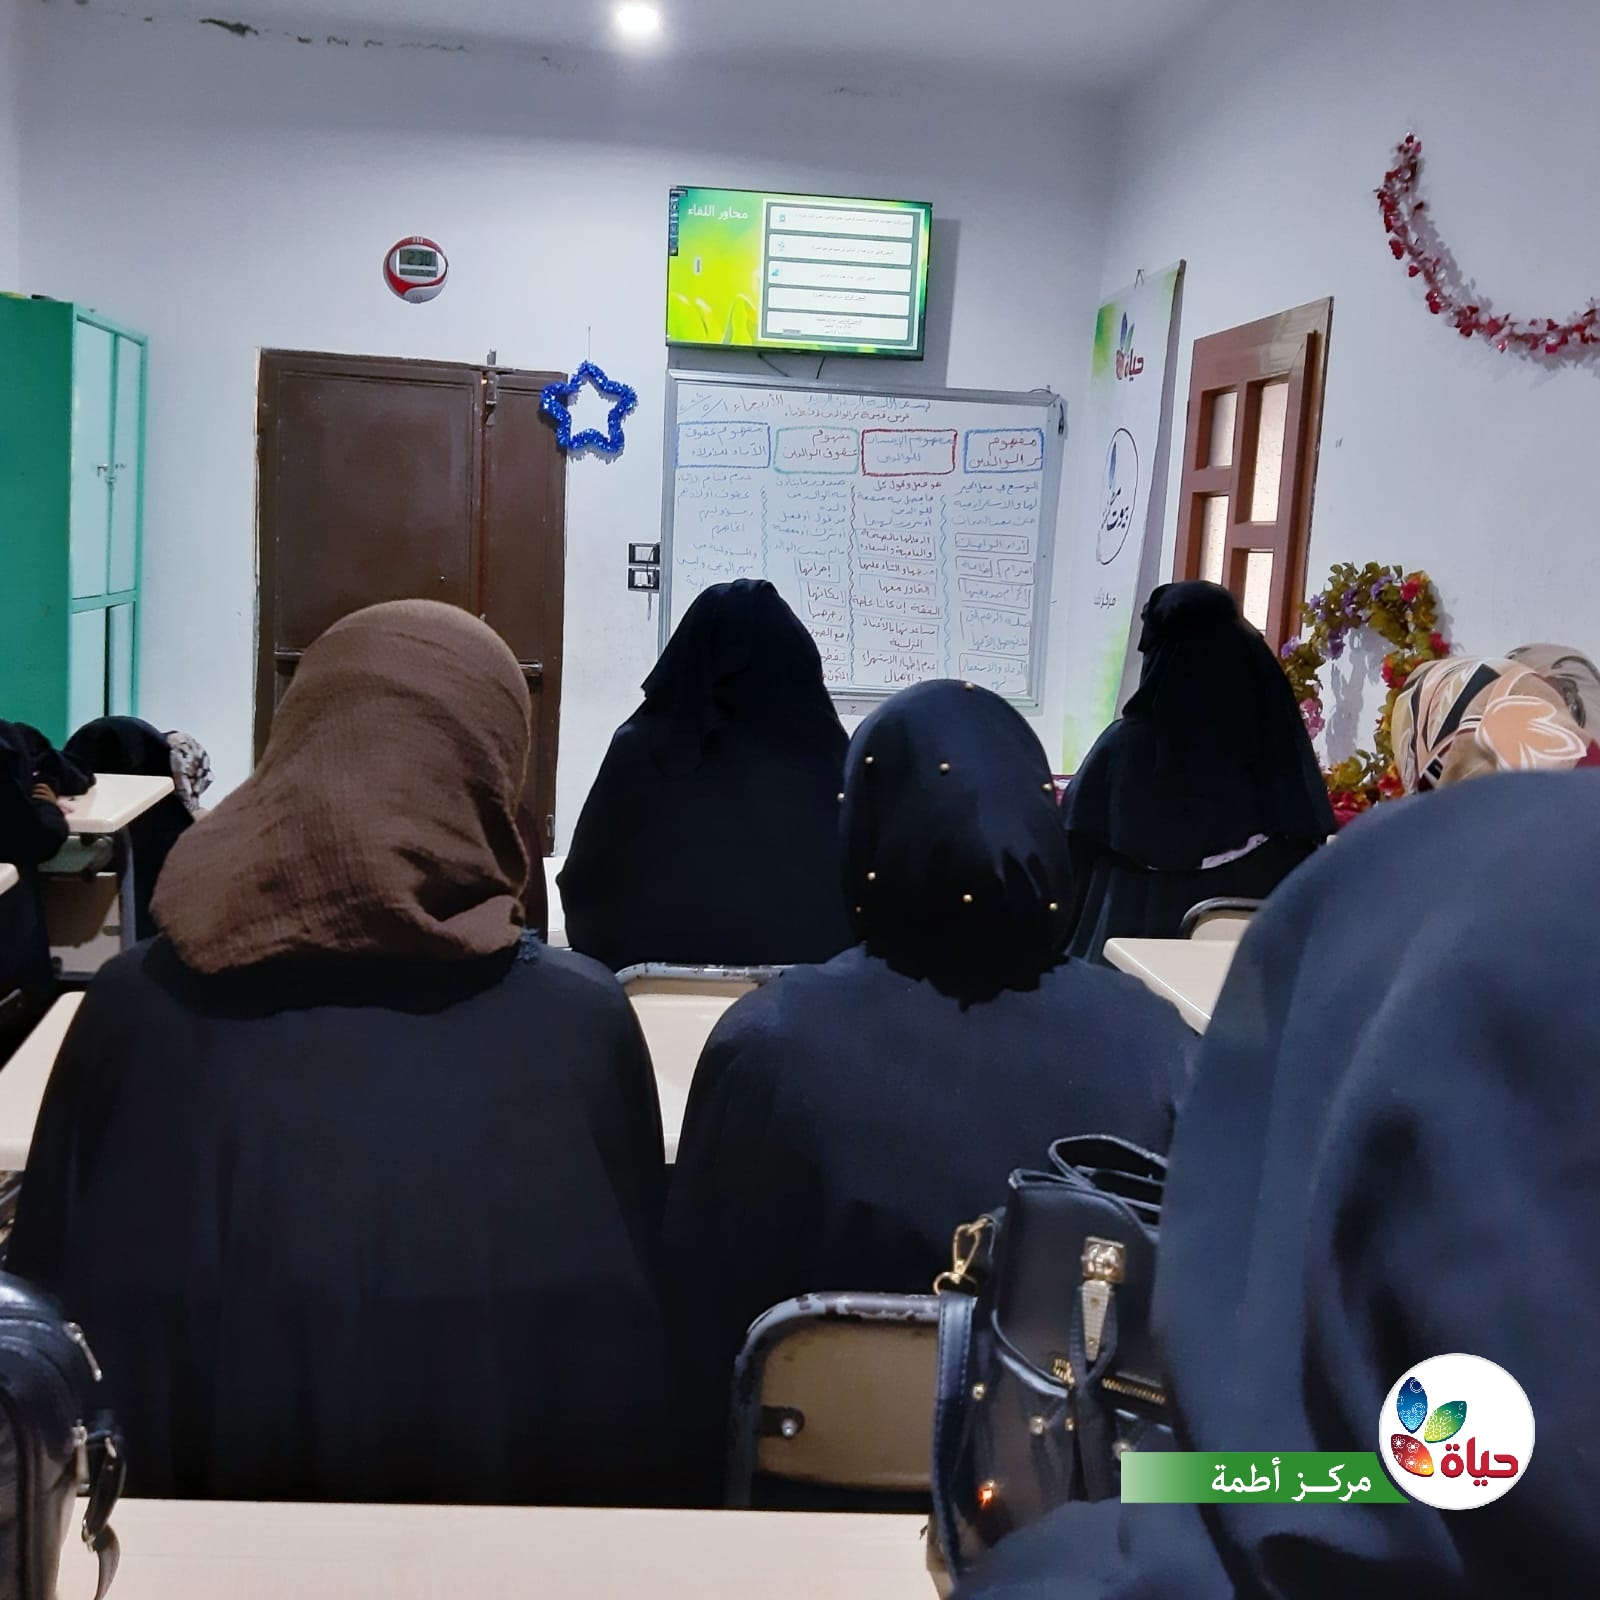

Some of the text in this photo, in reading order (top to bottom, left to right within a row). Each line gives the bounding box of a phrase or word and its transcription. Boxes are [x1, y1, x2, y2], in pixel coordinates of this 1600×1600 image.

[717, 206, 749, 222] محاور
[717, 426, 763, 448] مفهوم
[811, 429, 851, 448] مفهوم
[908, 436, 953, 454] مفهوم
[988, 437, 1037, 457] مفهوم
[968, 453, 1024, 470] الوالدين
